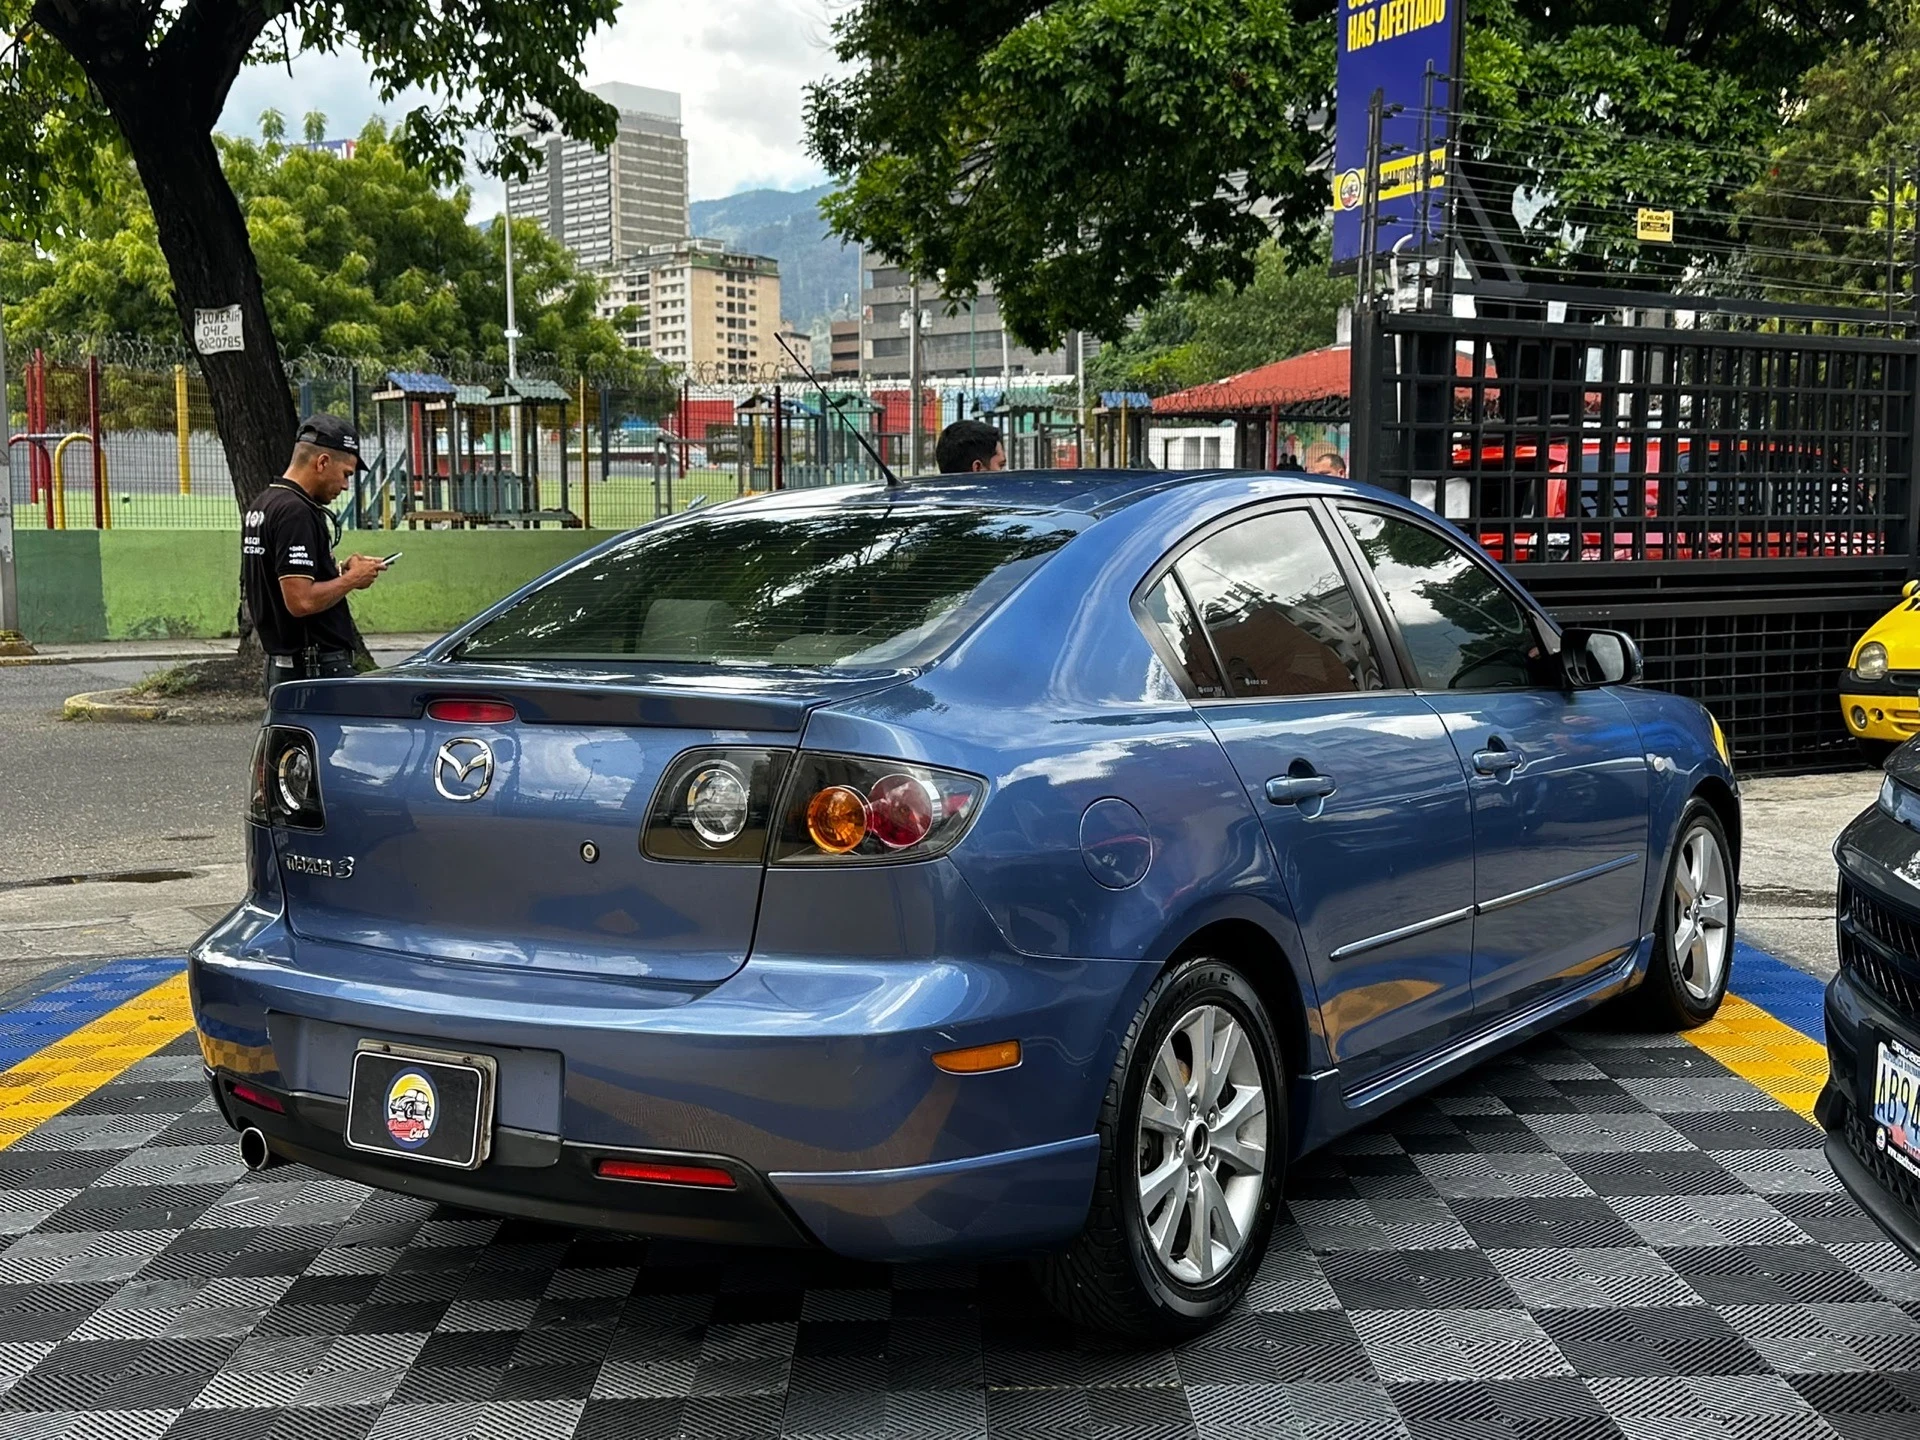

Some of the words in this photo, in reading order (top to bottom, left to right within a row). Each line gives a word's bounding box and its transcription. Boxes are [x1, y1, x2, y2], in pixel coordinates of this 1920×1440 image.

[1347, 8, 1377, 52] HAS
[1377, 0, 1446, 42] AFEITADO
[203, 324, 229, 337] 0412
[335, 855, 355, 879] 3
[409, 1127, 430, 1139] Cars
